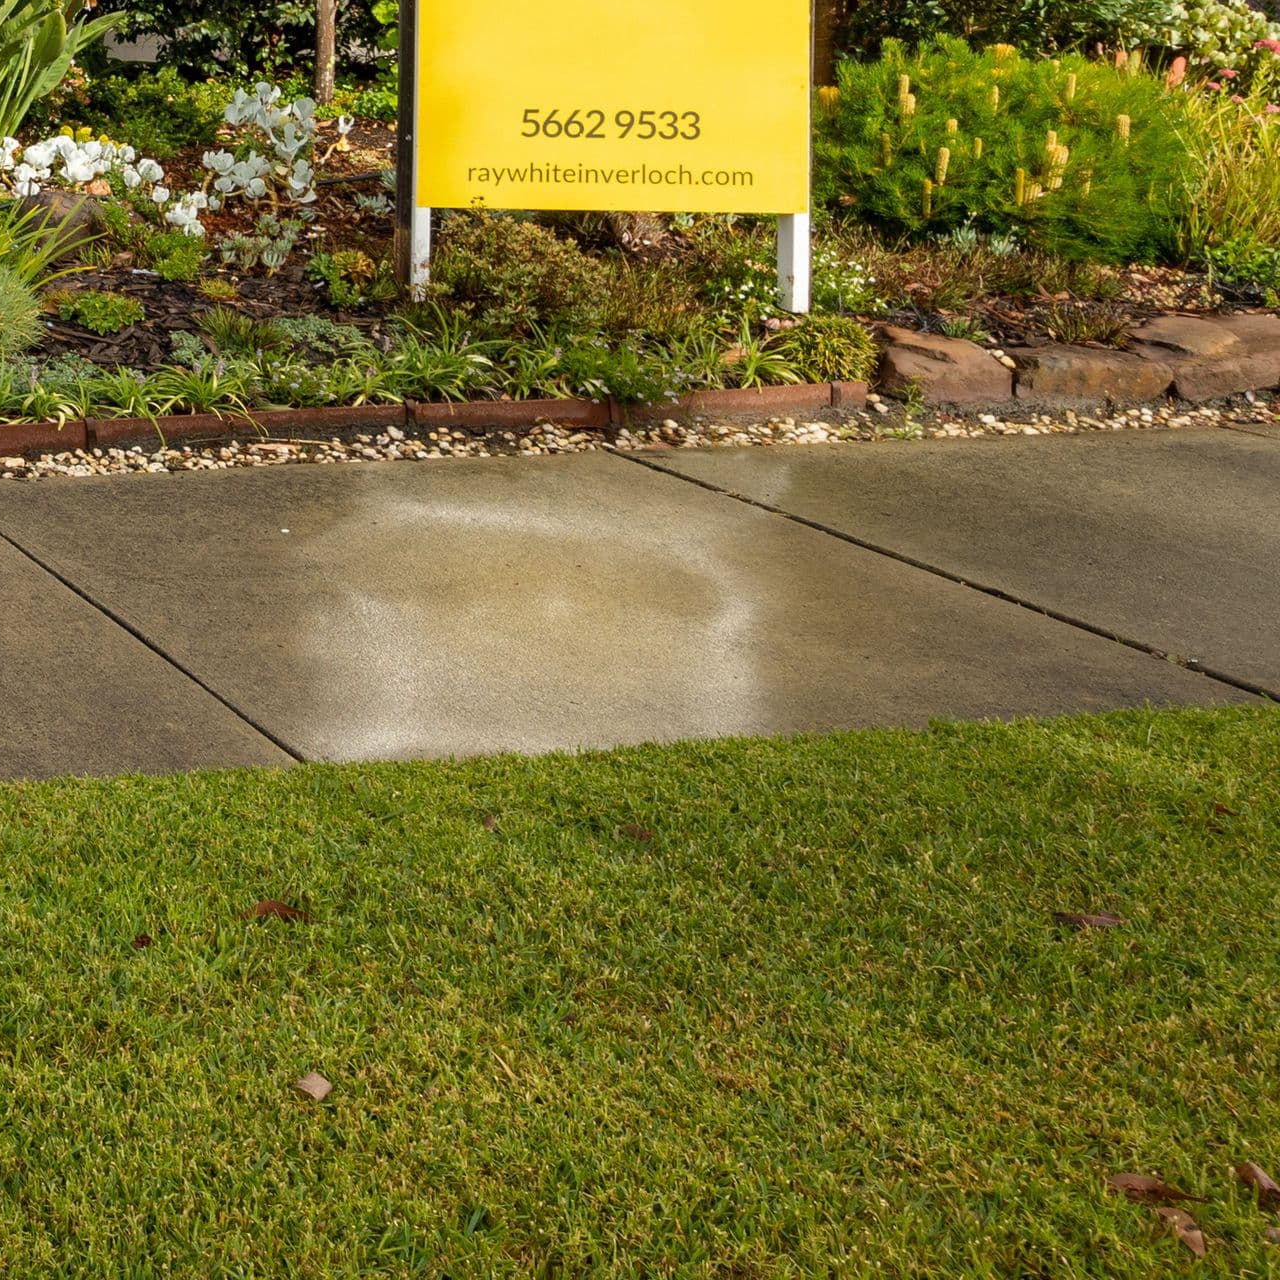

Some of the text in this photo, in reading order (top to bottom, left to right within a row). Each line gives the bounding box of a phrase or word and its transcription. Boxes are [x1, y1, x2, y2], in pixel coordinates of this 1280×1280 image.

[521, 109, 702, 141] 5662 9533
[467, 162, 755, 188] raywhiteinverloch.com
